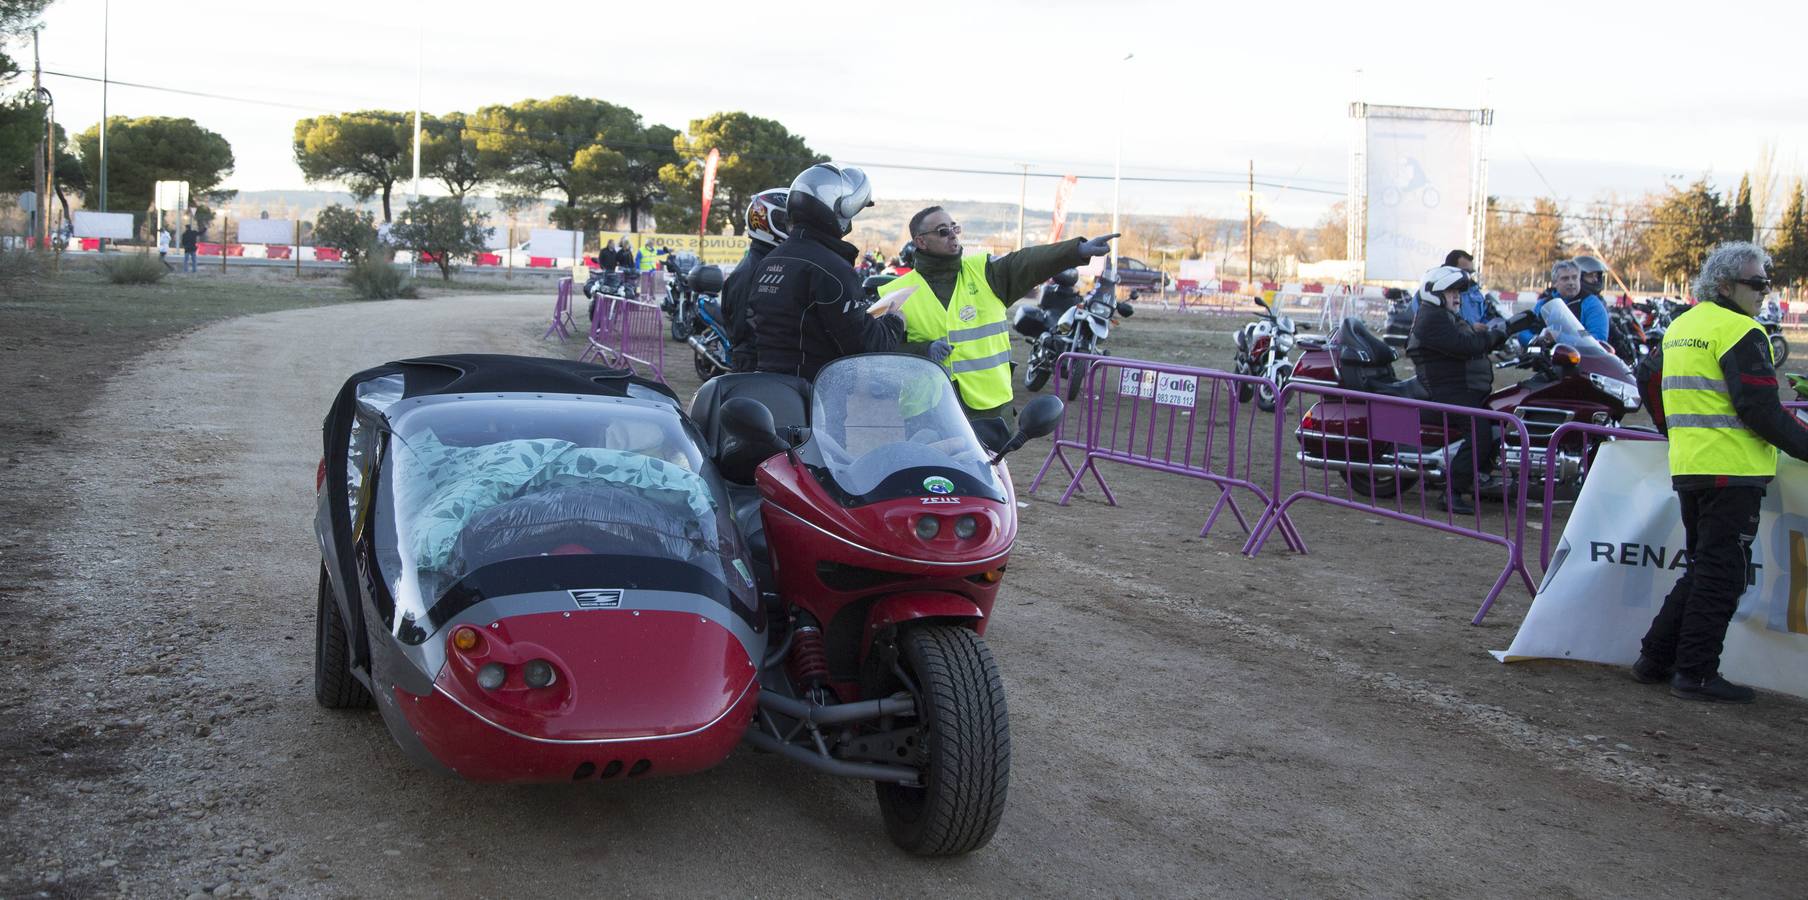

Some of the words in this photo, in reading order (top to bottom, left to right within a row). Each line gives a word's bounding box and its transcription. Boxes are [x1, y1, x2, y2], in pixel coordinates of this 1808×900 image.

[1169, 378, 1195, 393] alfe
[1157, 393, 1169, 403] 983
[1183, 396, 1194, 406] 112
[1590, 541, 1763, 586] RENAT
